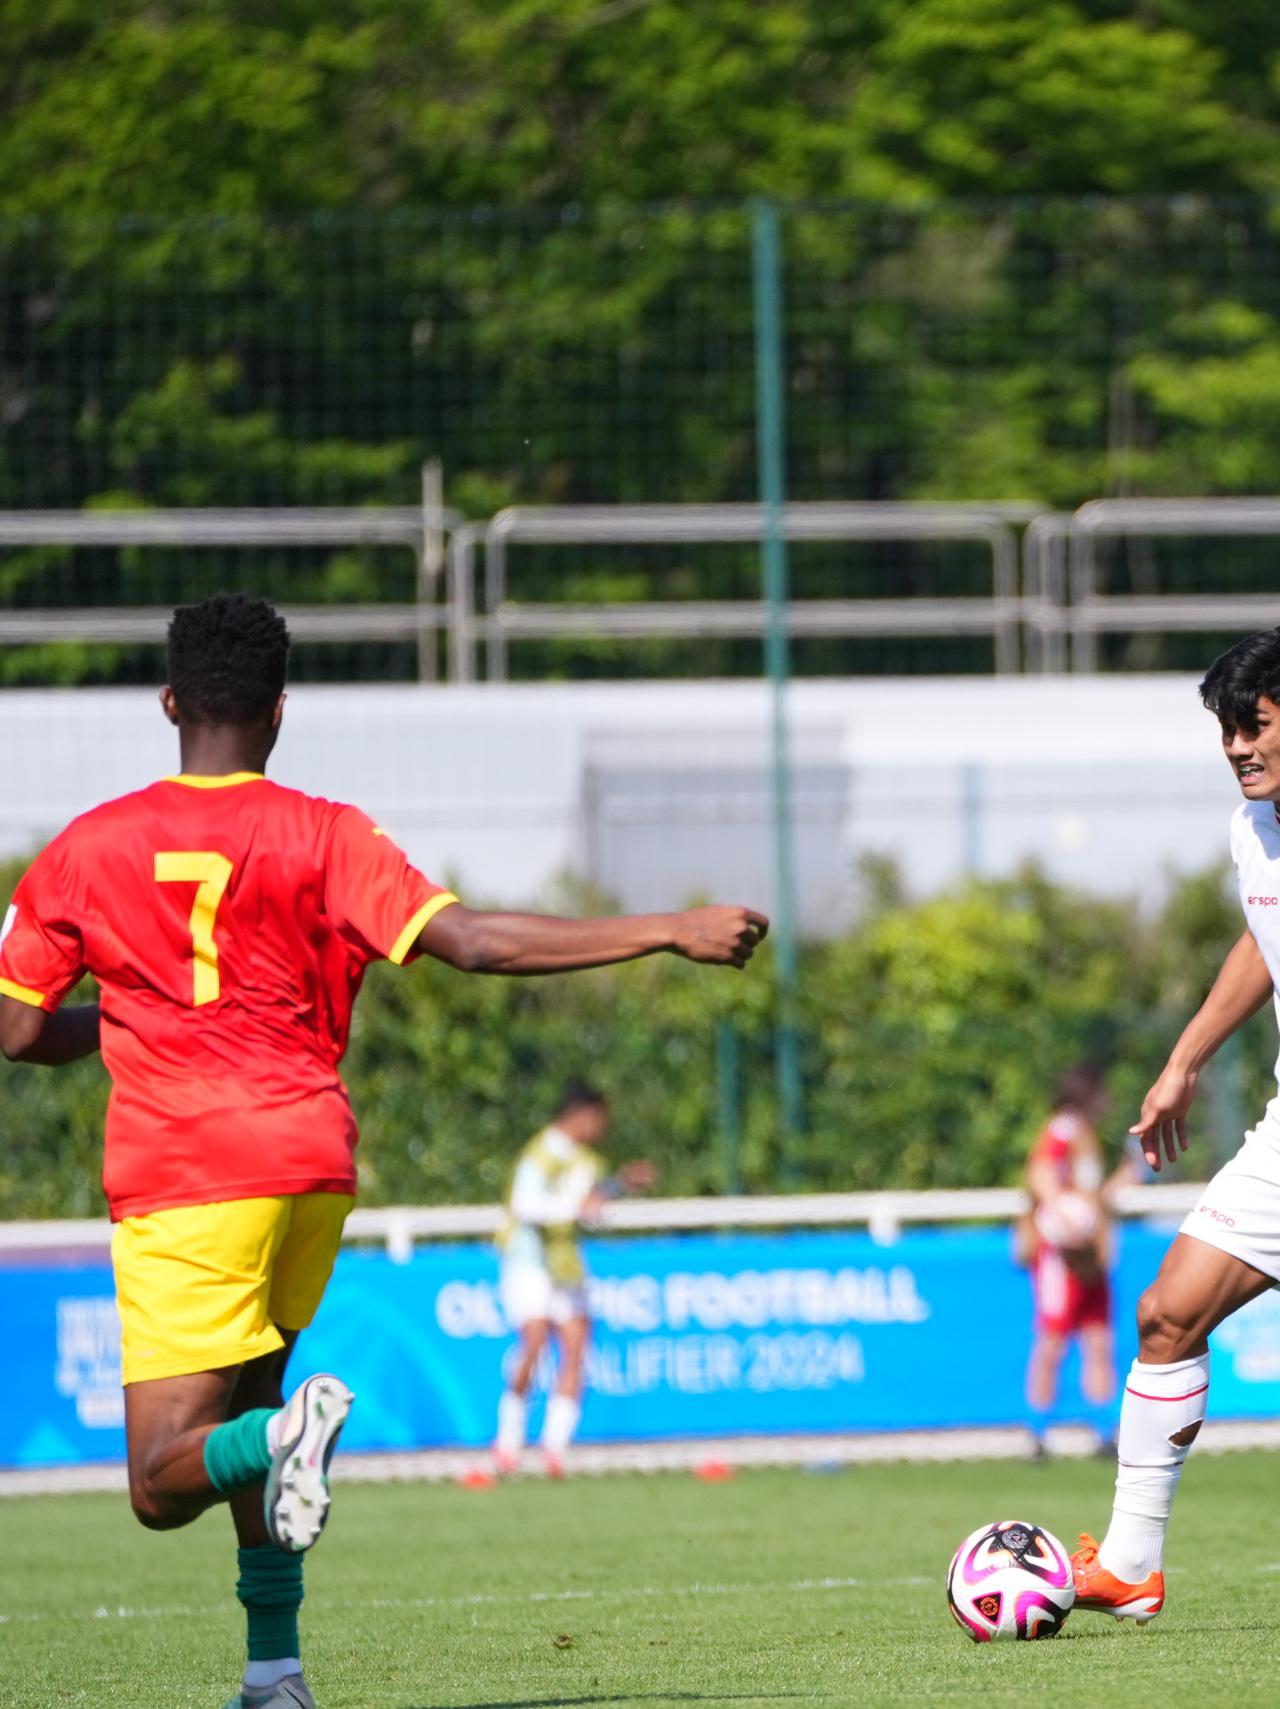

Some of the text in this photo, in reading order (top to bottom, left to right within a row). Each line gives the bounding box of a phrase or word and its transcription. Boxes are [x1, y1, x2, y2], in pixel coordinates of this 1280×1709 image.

[154, 852, 234, 1007] 7
[1247, 896, 1279, 908] erspo
[1199, 1205, 1236, 1228] erspo
[664, 1264, 930, 1330] FOOTBALL
[744, 1330, 866, 1392] 2024
